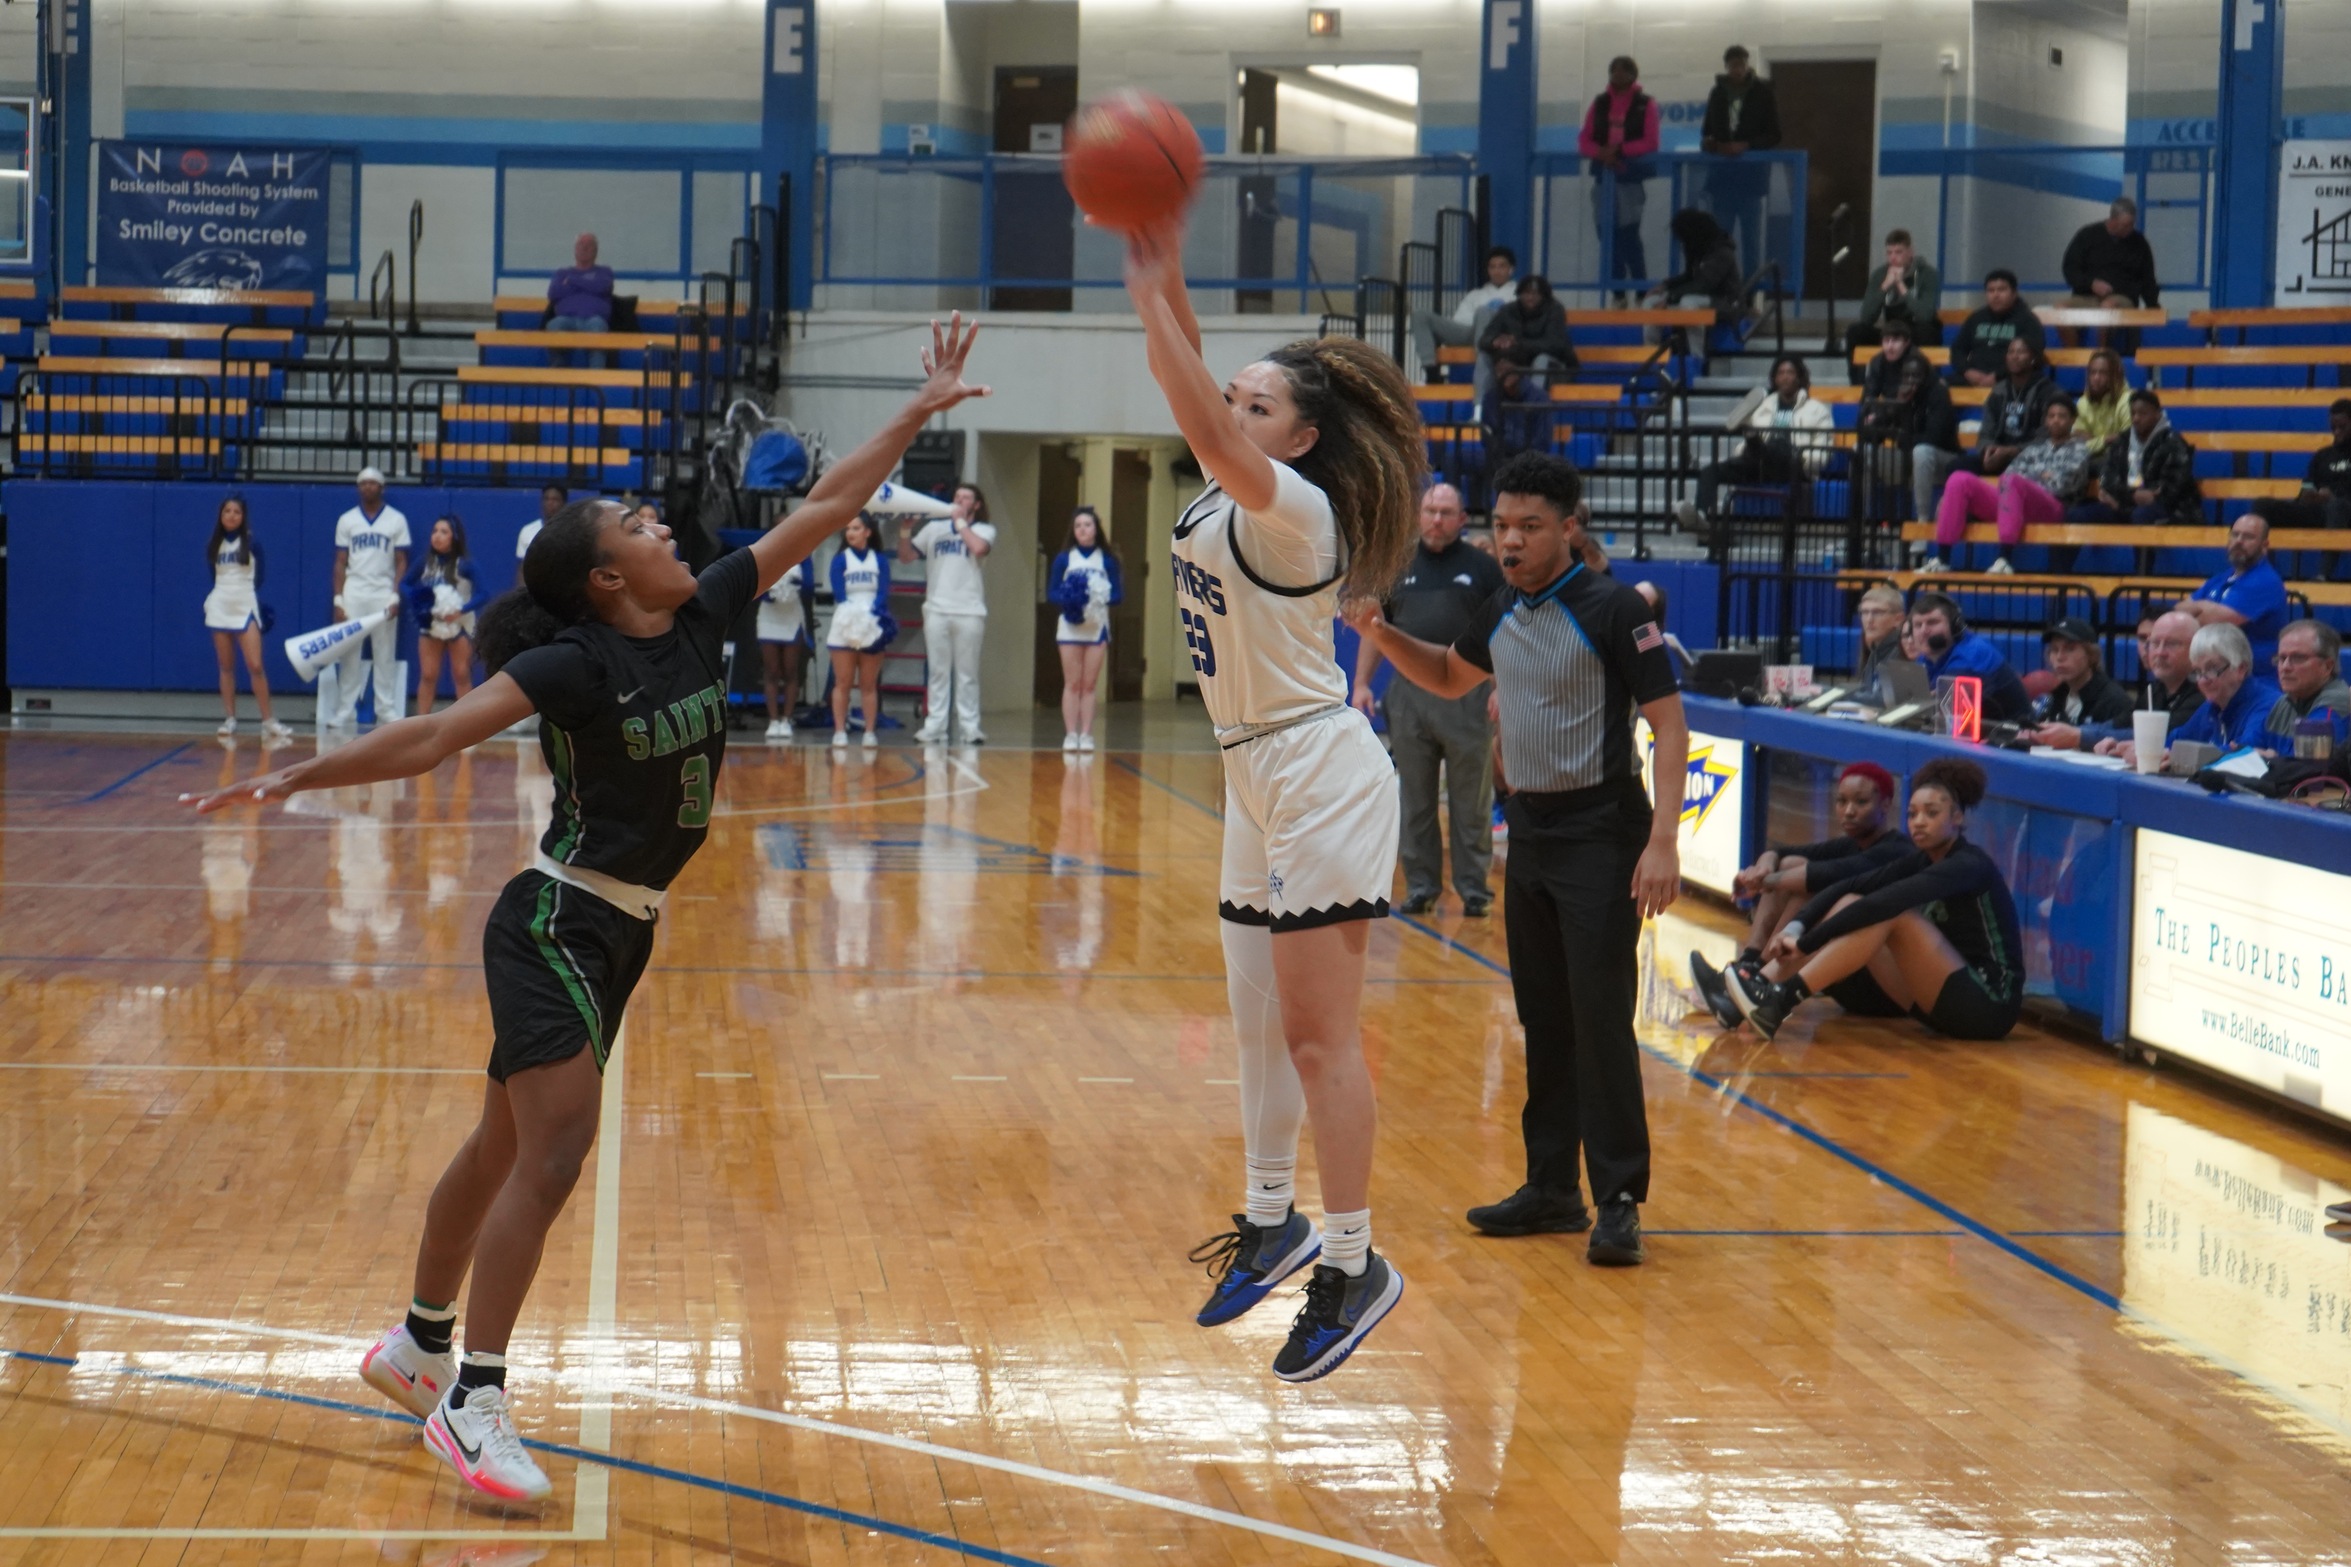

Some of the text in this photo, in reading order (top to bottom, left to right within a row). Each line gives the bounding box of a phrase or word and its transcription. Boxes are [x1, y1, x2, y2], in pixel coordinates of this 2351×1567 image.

[773, 8, 804, 73] E
[1490, 1, 1521, 69] F
[2293, 155, 2324, 170] J.A.
[110, 178, 318, 201] Basketball Shooting System
[167, 199, 259, 219] Provided by
[119, 219, 308, 246] Smiley Concrete
[351, 532, 392, 553] PRATT
[299, 621, 362, 659] BEAVERS
[677, 753, 712, 828] 3
[1685, 771, 1714, 801] ION
[2201, 1008, 2320, 1069] www.BelleBank.com
